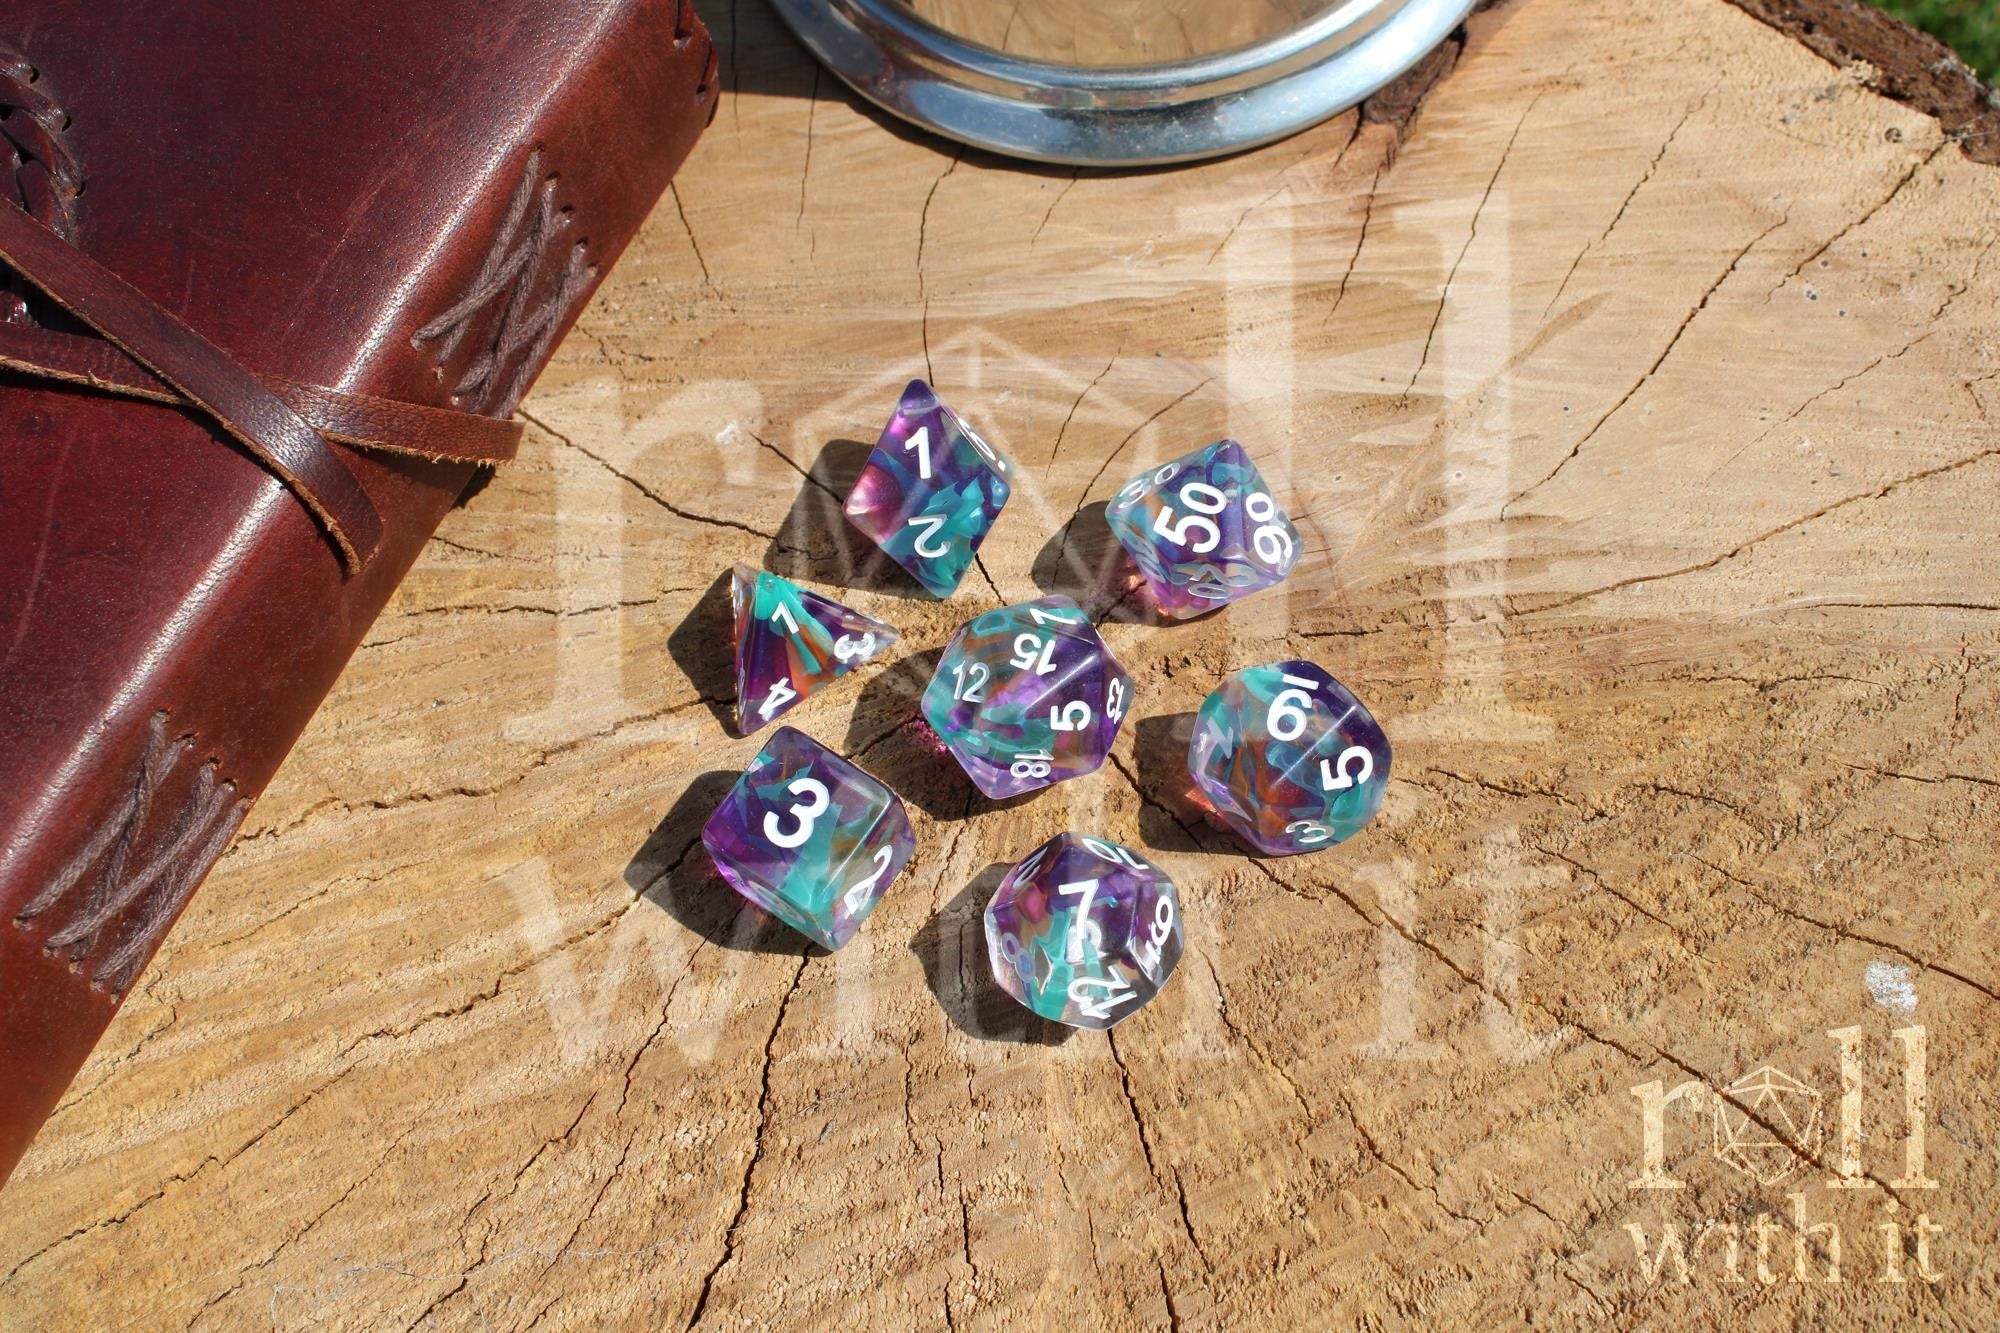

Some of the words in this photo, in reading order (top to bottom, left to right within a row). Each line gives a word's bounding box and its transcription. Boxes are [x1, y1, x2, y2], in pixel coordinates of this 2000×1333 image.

[905, 426, 932, 479] 1
[908, 513, 951, 558] 2
[1152, 482, 1227, 553] 50
[771, 601, 799, 634] 1
[833, 632, 876, 662] 3
[1010, 633, 1057, 676] 15
[758, 677, 797, 718] 4
[952, 660, 991, 703] 12
[1106, 677, 1124, 724] 13
[1050, 700, 1091, 731] 5
[1010, 750, 1054, 778] 18
[1320, 745, 1374, 791] 5
[763, 777, 830, 848] 3
[1285, 819, 1335, 844] 3
[843, 844, 894, 916] 2
[1058, 879, 1100, 941] 7
